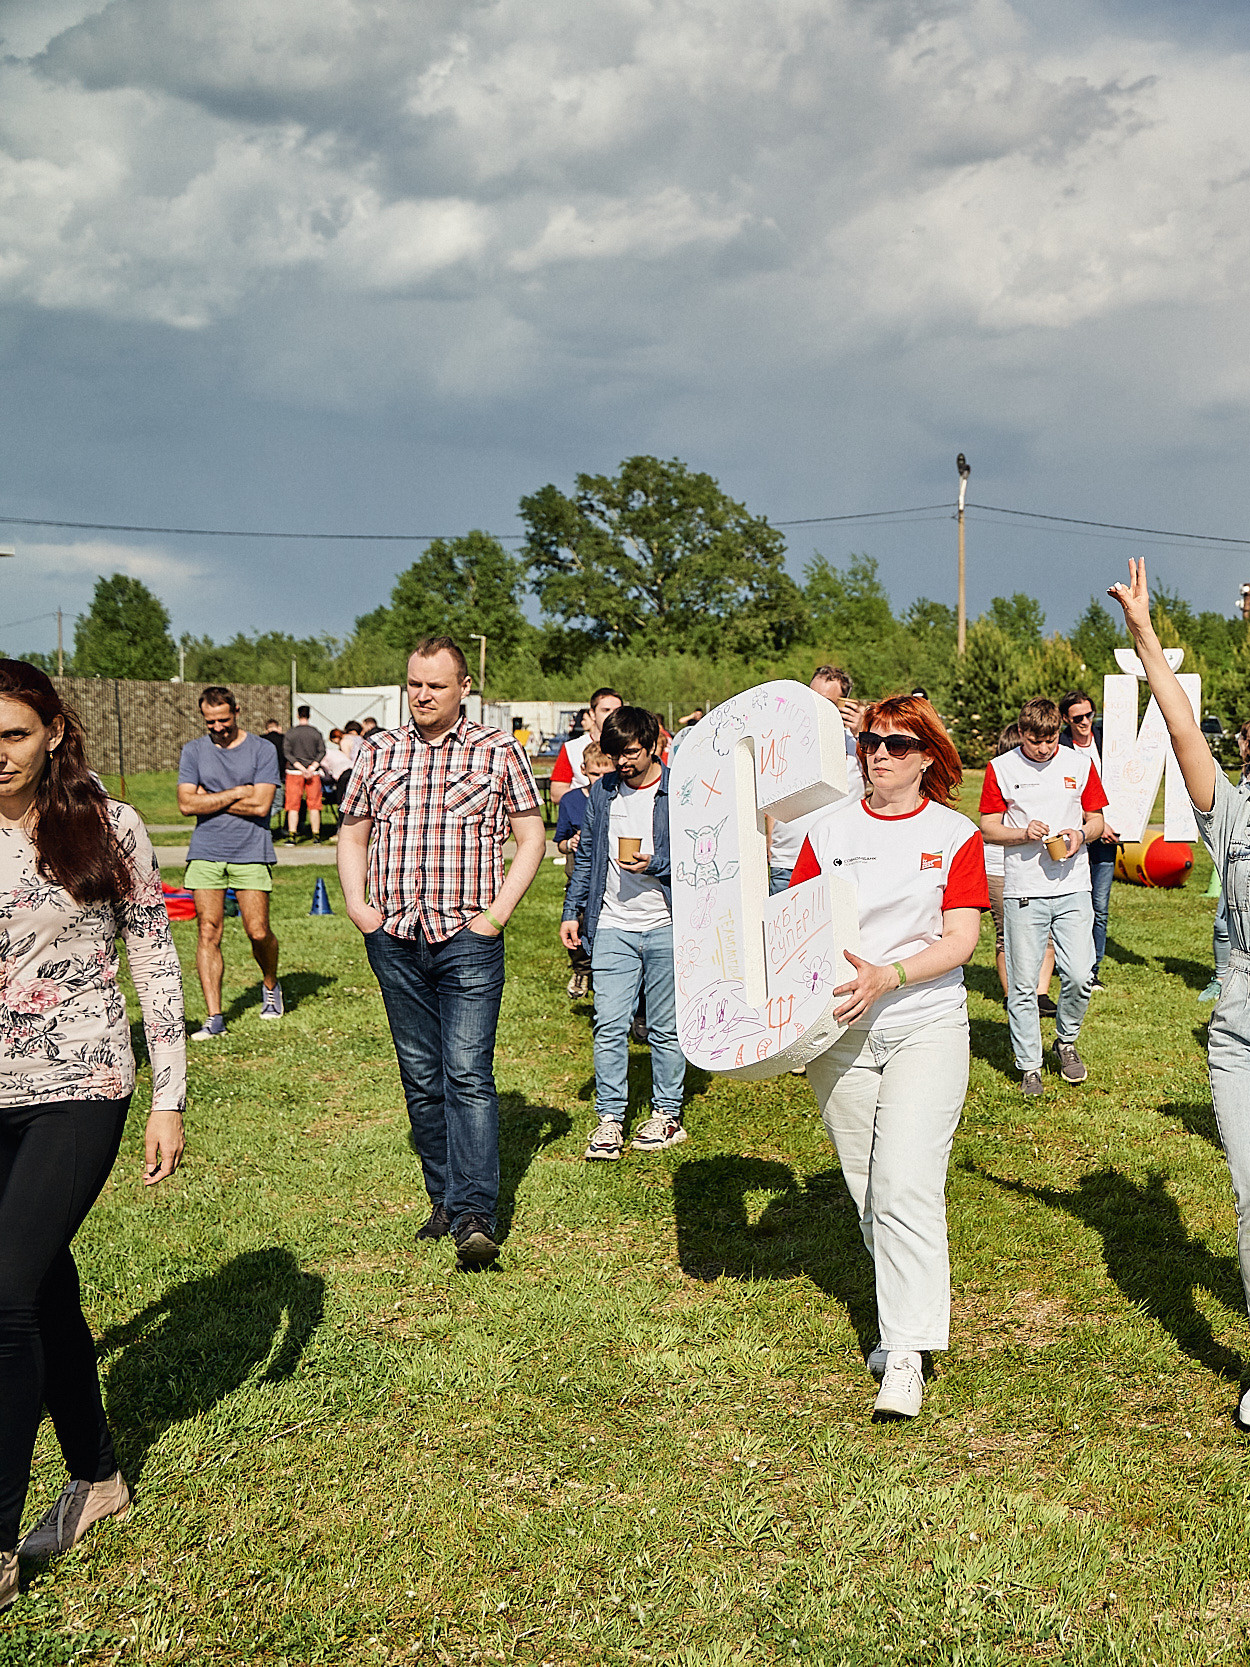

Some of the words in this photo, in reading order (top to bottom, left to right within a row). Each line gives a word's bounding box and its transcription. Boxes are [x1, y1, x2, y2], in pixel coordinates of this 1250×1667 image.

[775, 696, 816, 754] ТИГРЫ
[768, 892, 799, 945] СКБТ
[771, 886, 825, 965] СУПЕР!!!
